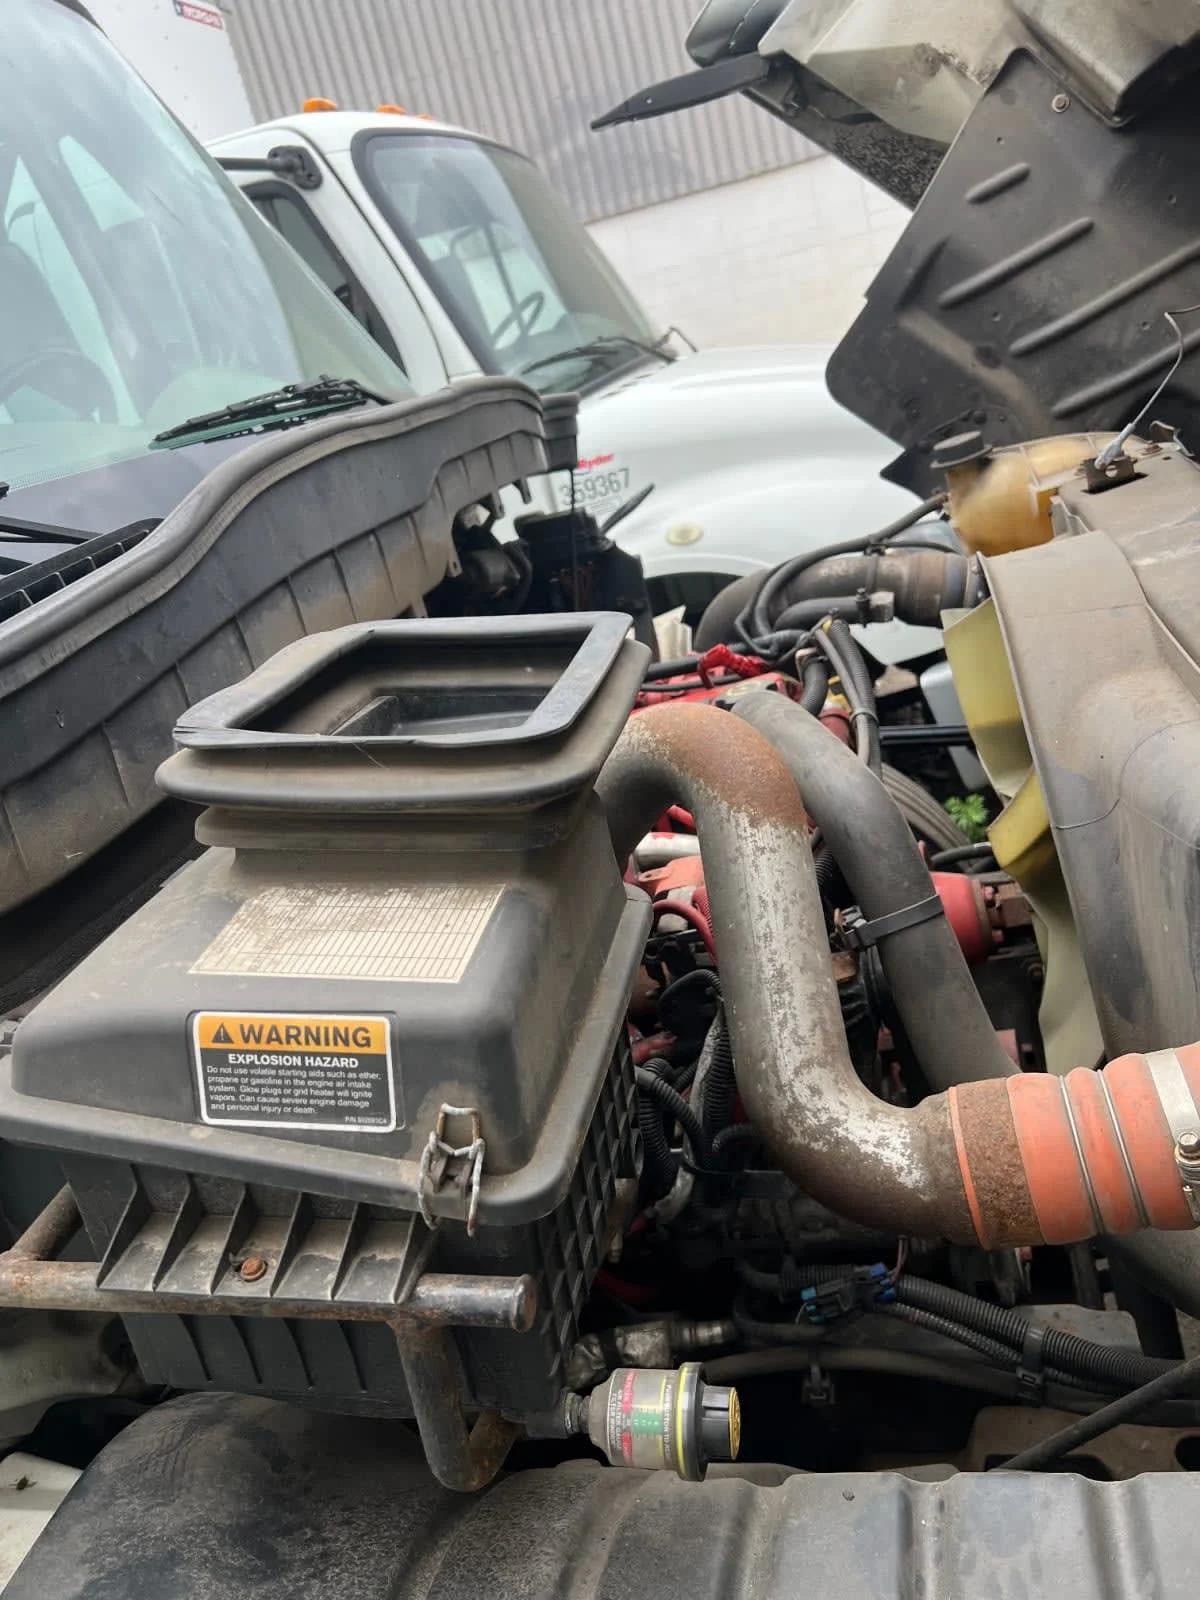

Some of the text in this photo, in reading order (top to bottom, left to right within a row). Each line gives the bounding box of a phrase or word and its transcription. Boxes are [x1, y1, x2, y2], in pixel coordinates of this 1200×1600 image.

[559, 468, 630, 506] 359367
[239, 1024, 372, 1048] WARNING
[228, 1053, 359, 1068] EXPLOSION HAZARD
[278, 1069, 307, 1078] starting
[208, 1076, 239, 1084] propane
[250, 1077, 282, 1085] gasoline
[307, 1080, 333, 1088] engine
[261, 1087, 282, 1096] plugs
[293, 1088, 308, 1096] grid
[310, 1088, 334, 1096] heater
[351, 1090, 372, 1099] ignite
[261, 1105, 281, 1114] injury
[309, 1098, 336, 1107] engine
[338, 1099, 370, 1109] damage
